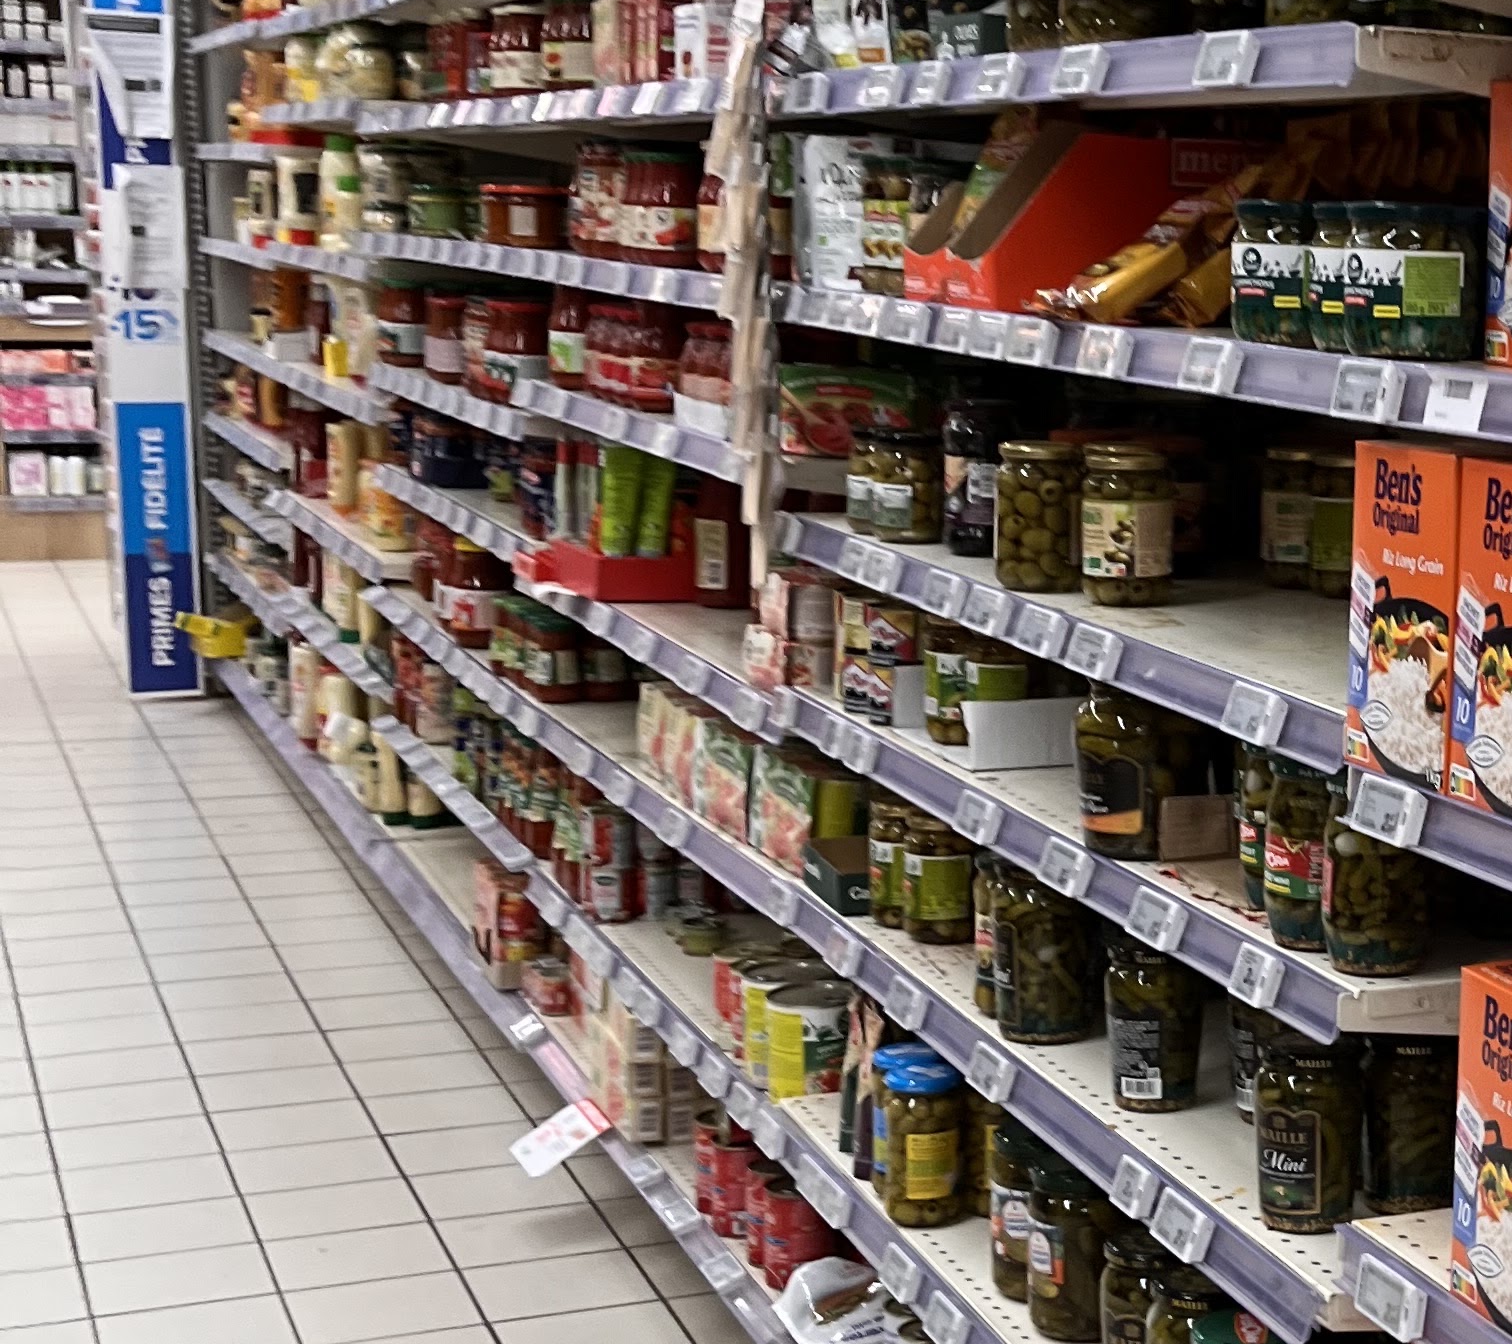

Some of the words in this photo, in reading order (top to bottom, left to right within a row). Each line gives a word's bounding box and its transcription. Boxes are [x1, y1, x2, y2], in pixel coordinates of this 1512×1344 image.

[1375, 458, 1422, 506] Ben's
[1373, 502, 1419, 536] Original
[148, 577, 176, 667] PRIMES
[1264, 1147, 1308, 1173] Mini
